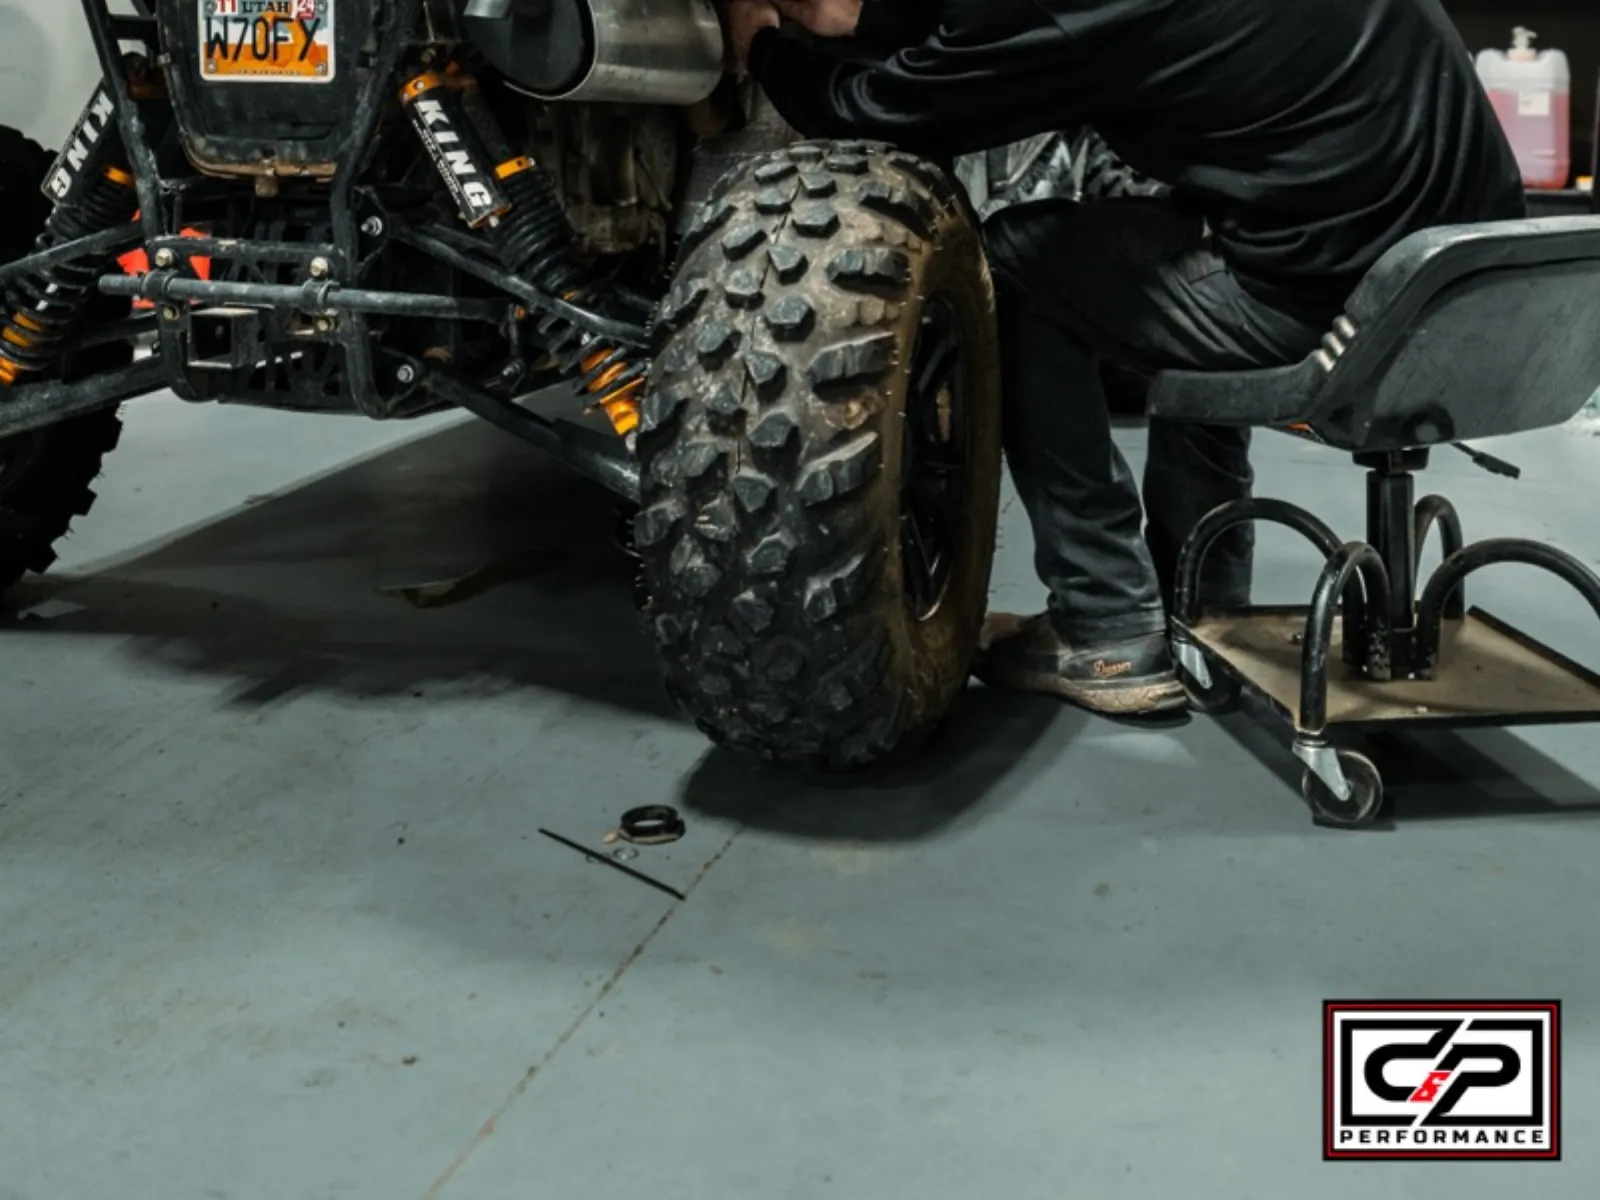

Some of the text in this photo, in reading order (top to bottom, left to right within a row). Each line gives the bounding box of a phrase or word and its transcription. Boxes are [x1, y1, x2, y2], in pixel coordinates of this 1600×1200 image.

[243, 1, 289, 13] UTAH
[49, 89, 115, 199] KING
[413, 99, 493, 208] KING
